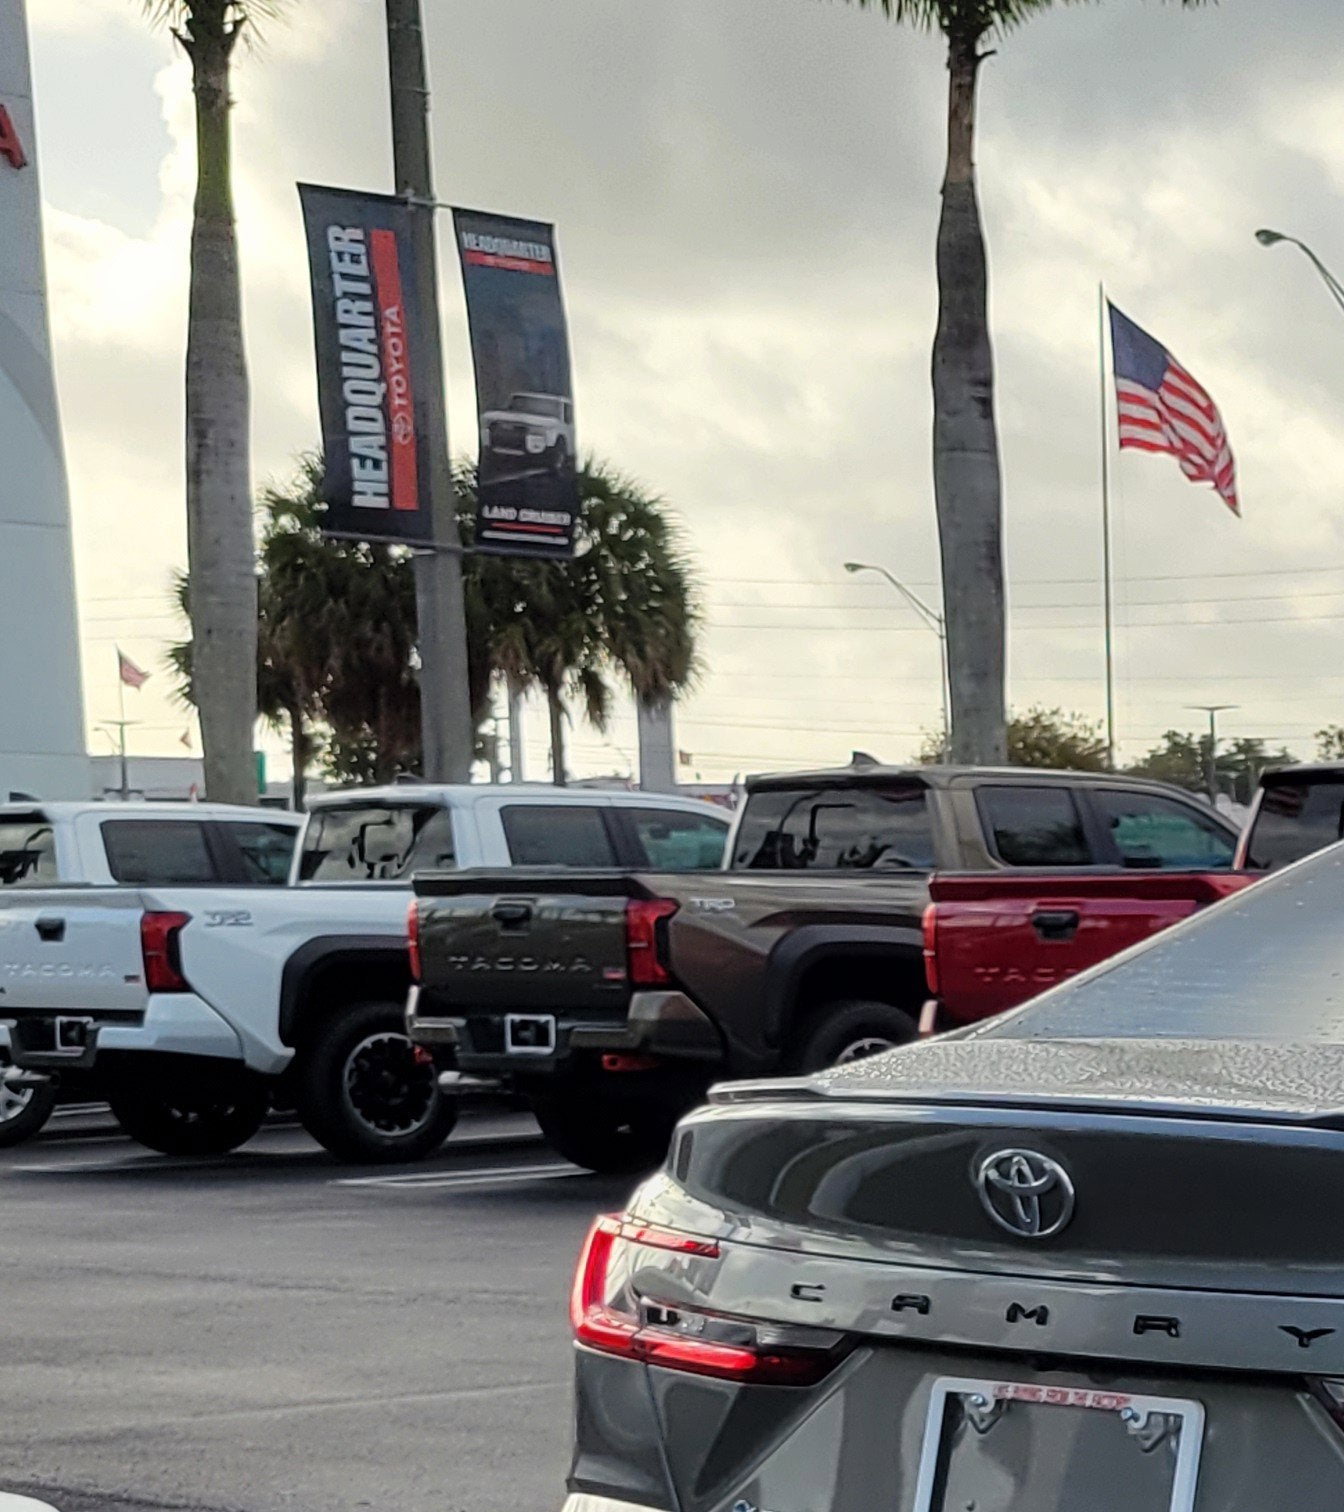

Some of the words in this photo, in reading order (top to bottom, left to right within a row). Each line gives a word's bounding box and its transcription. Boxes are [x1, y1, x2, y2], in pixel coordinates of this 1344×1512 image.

[327, 224, 391, 510] HEADQUARTER
[383, 305, 412, 406] TOYOTA
[4, 963, 117, 978] TACOMA
[448, 955, 593, 972] TACOMA
[789, 1281, 1337, 1349] CAMRY
